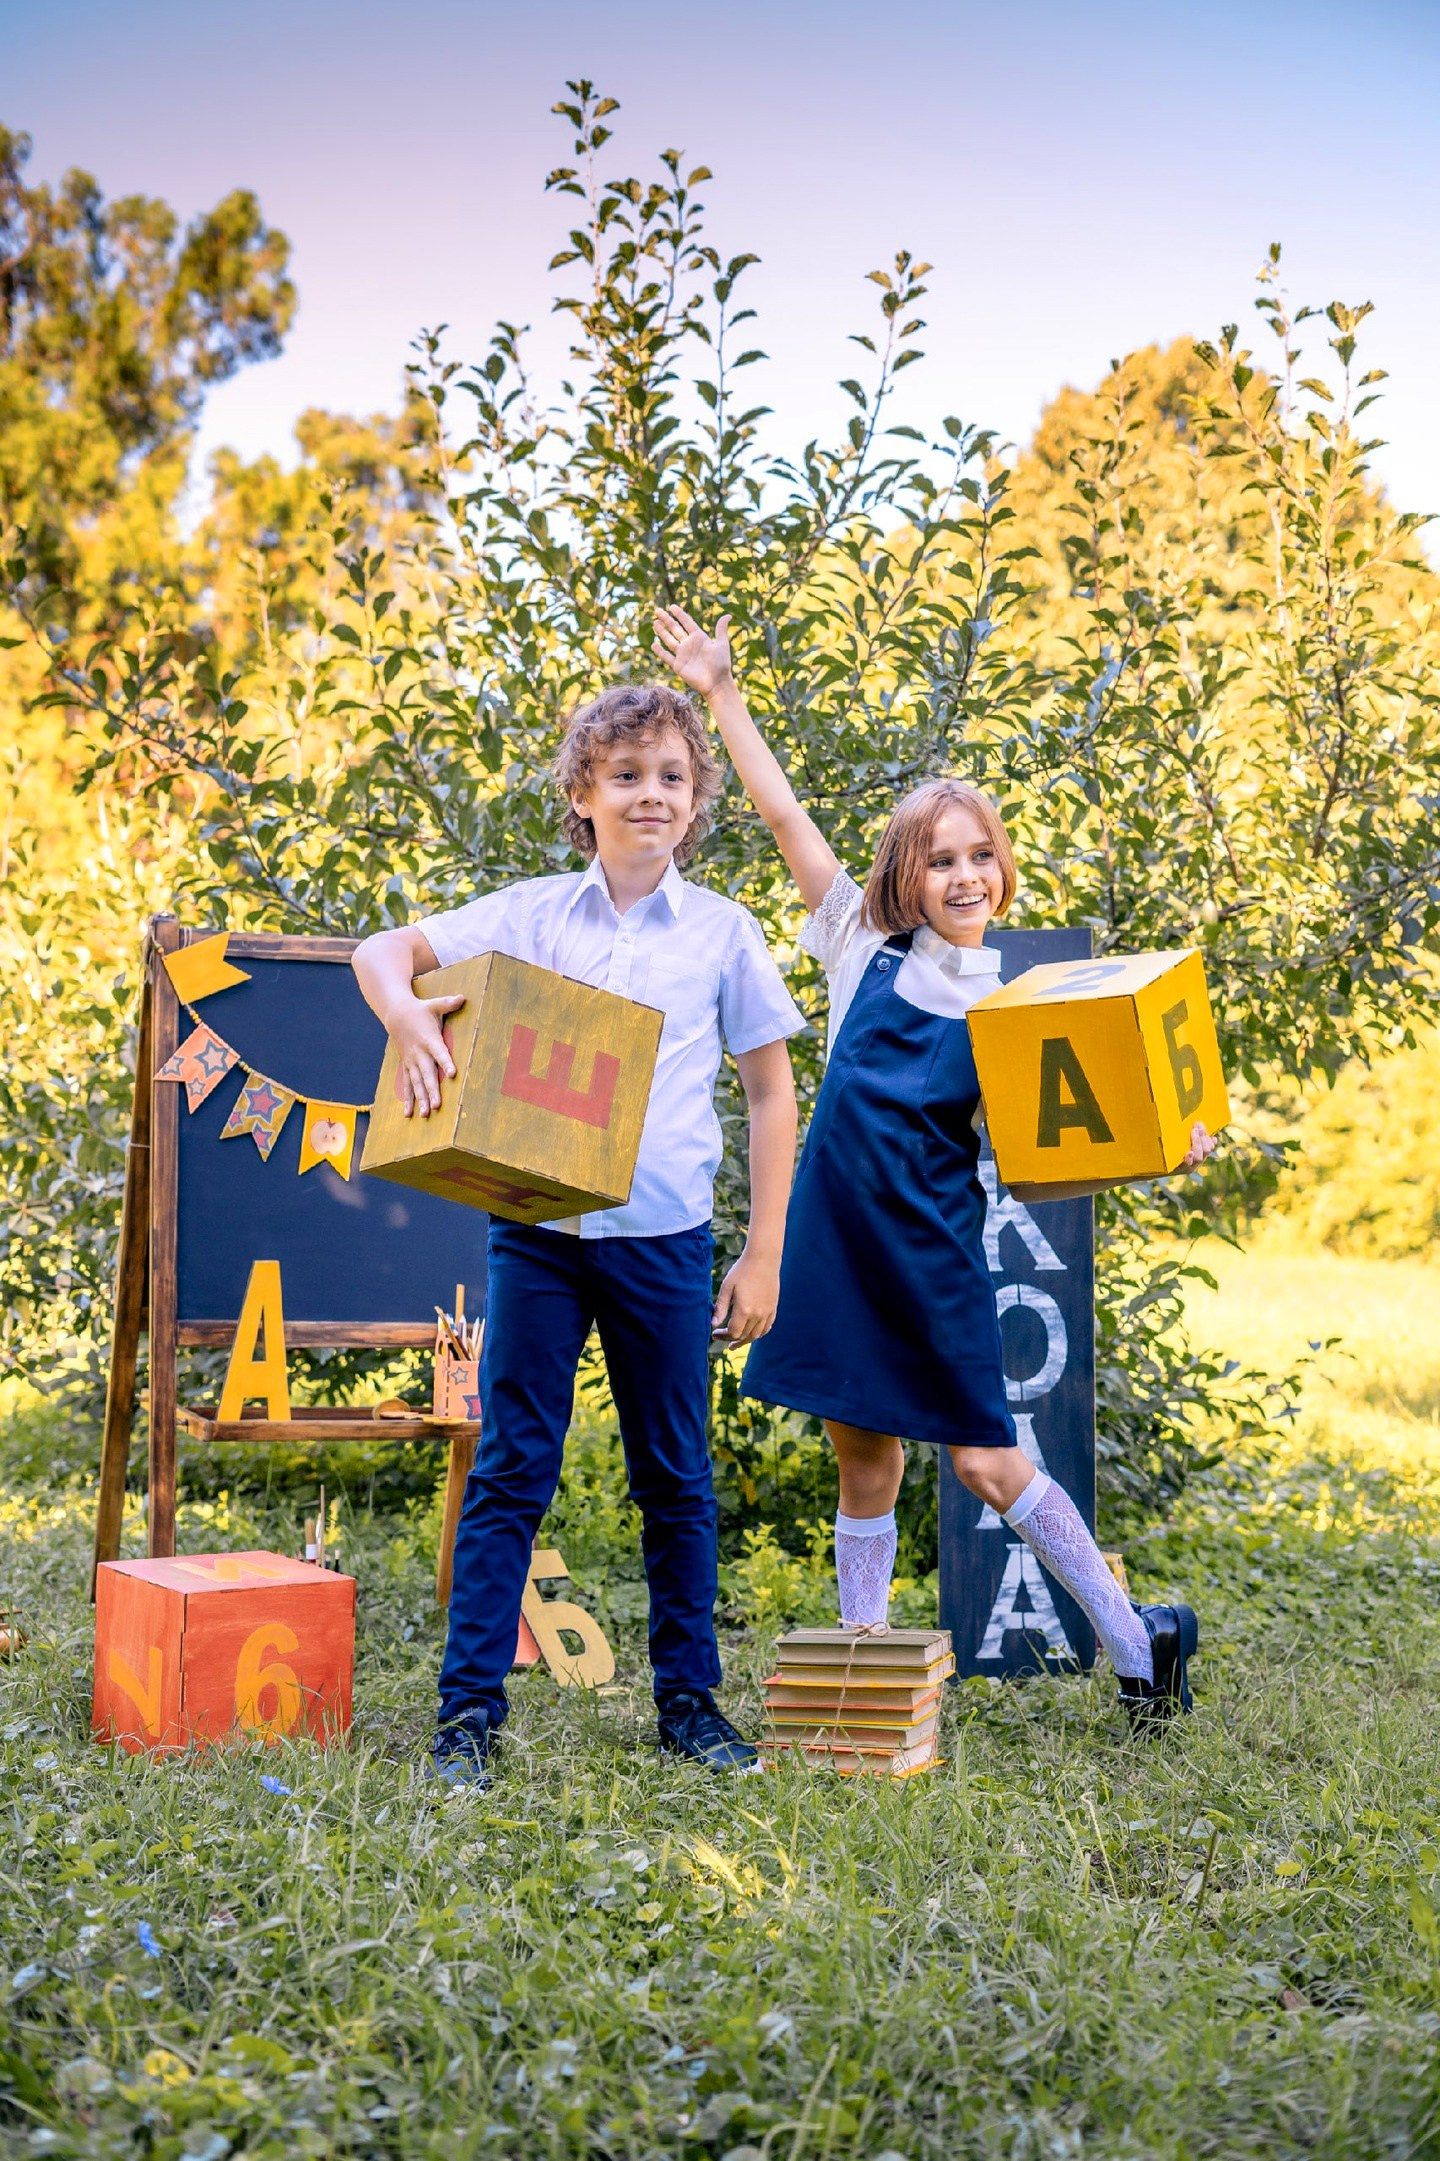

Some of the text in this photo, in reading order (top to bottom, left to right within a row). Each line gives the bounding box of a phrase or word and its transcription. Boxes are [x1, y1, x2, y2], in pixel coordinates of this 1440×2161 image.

[1032, 964, 1127, 997] 2
[1037, 1036, 1116, 1148] А
[1161, 998, 1204, 1122] Б
[217, 1260, 292, 1421] А
[234, 1623, 300, 1742] 6
